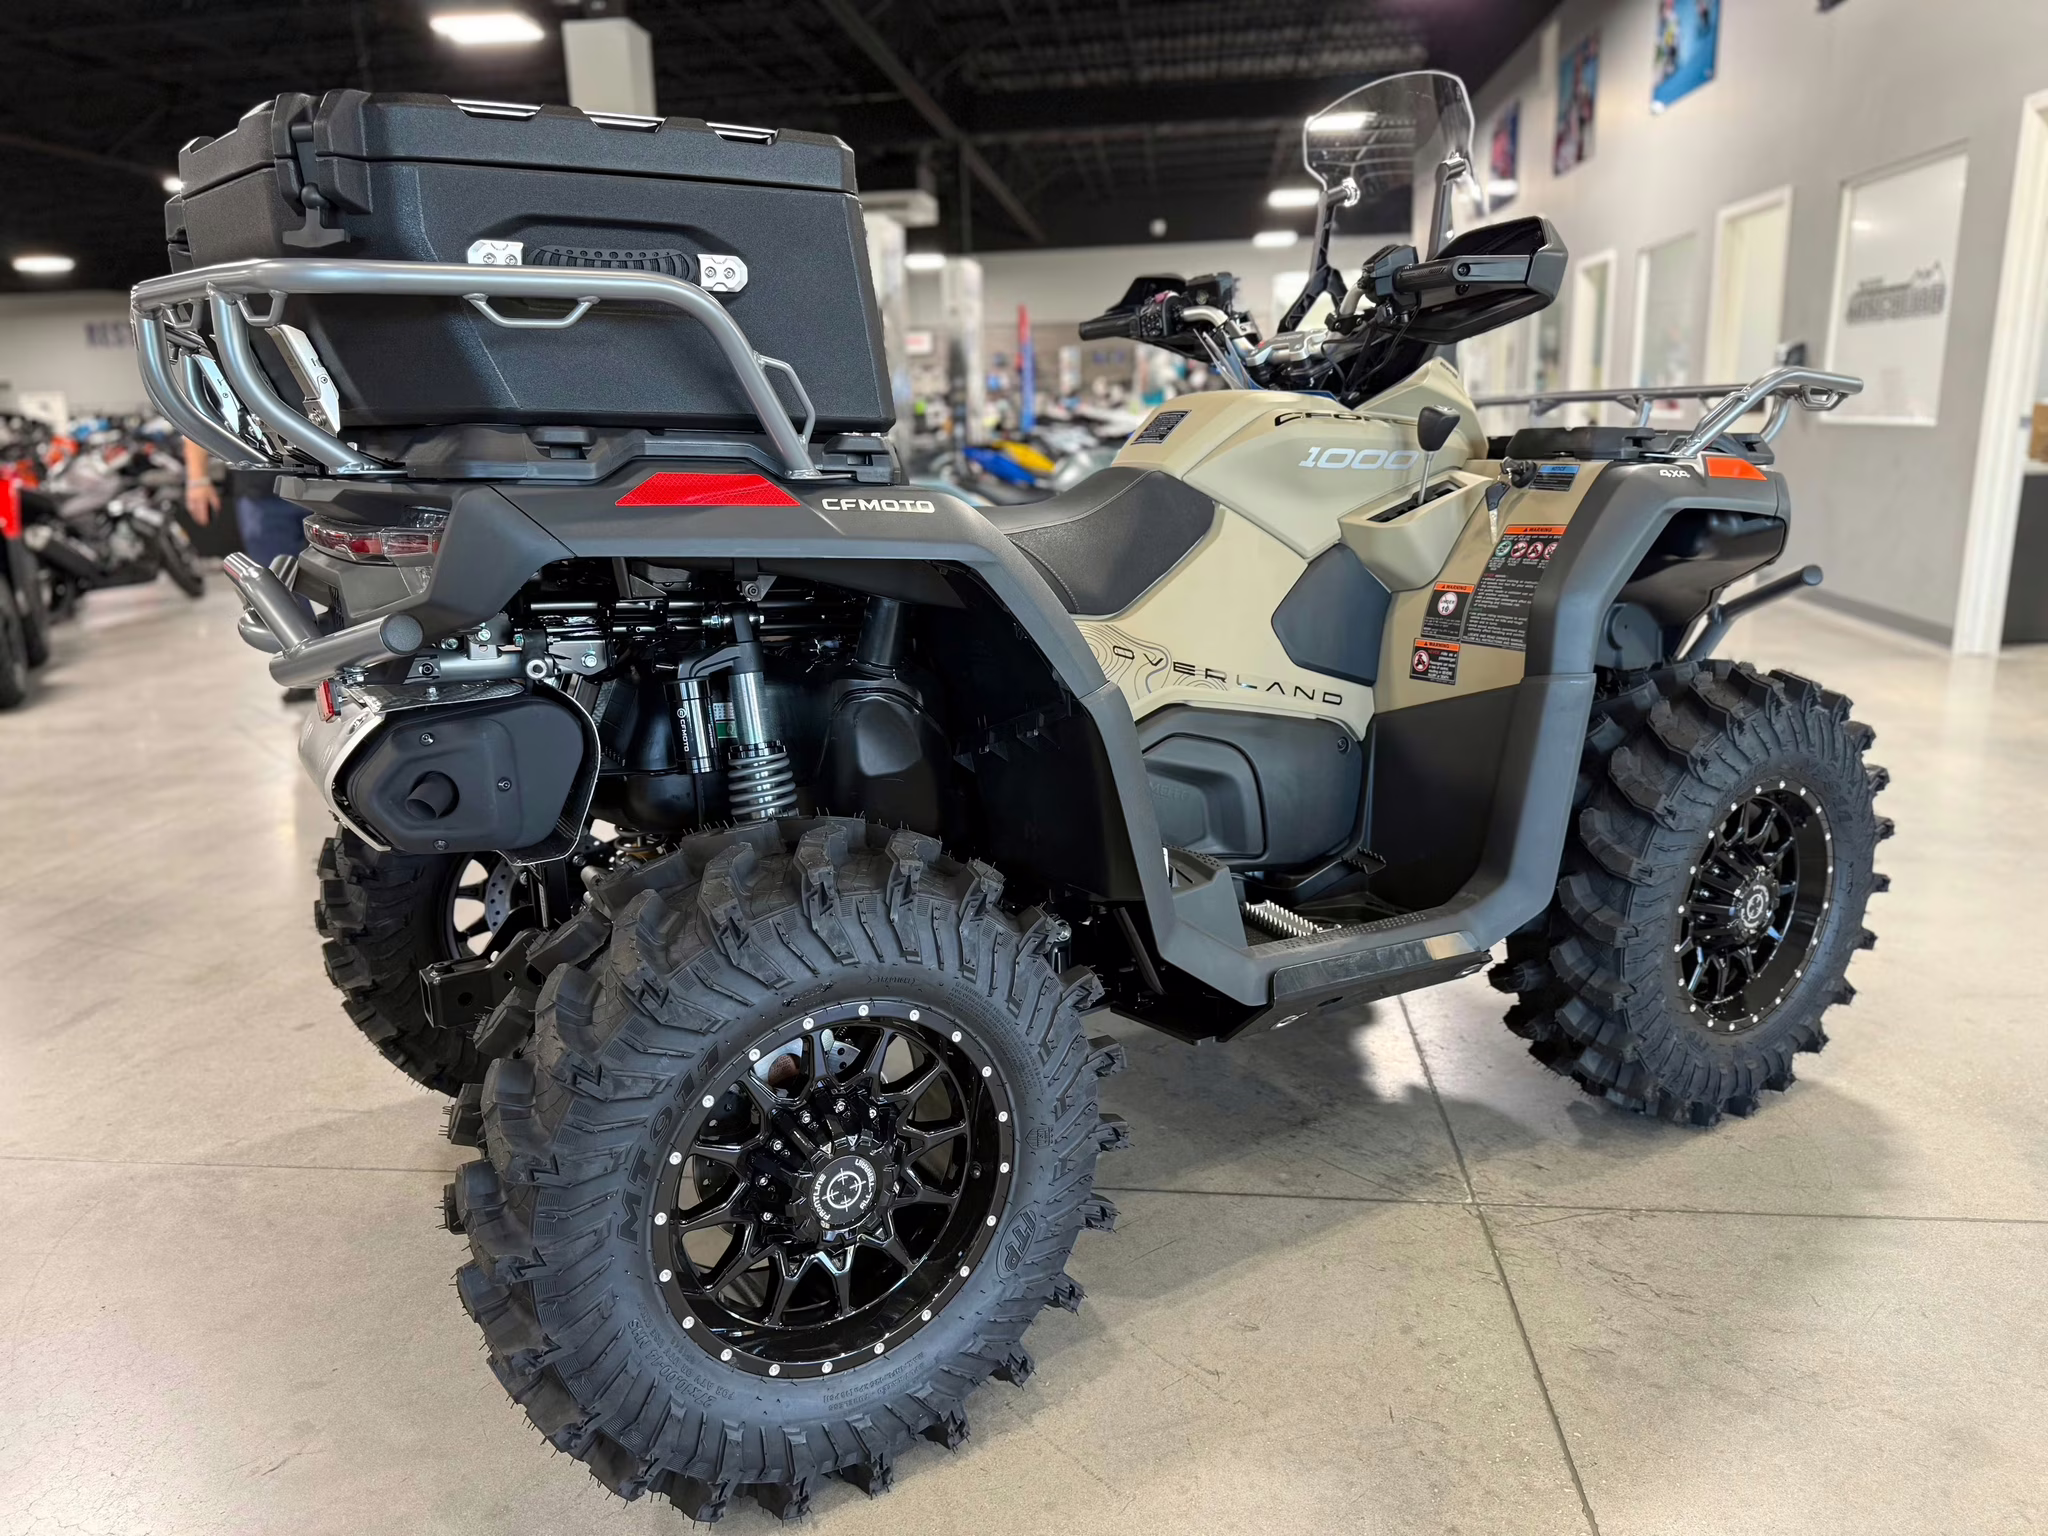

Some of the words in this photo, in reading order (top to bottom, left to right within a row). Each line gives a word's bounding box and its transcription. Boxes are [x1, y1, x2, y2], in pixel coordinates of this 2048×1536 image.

[1298, 446, 1420, 470] 1000
[821, 498, 935, 513] CFMOTO
[1112, 645, 1342, 705] OVERLAND
[680, 719, 690, 752] CFMOTO
[661, 1346, 681, 1367] UTV
[679, 1362, 693, 1377] OR
[692, 1374, 715, 1391] ATV
[714, 1384, 735, 1401] FOR
